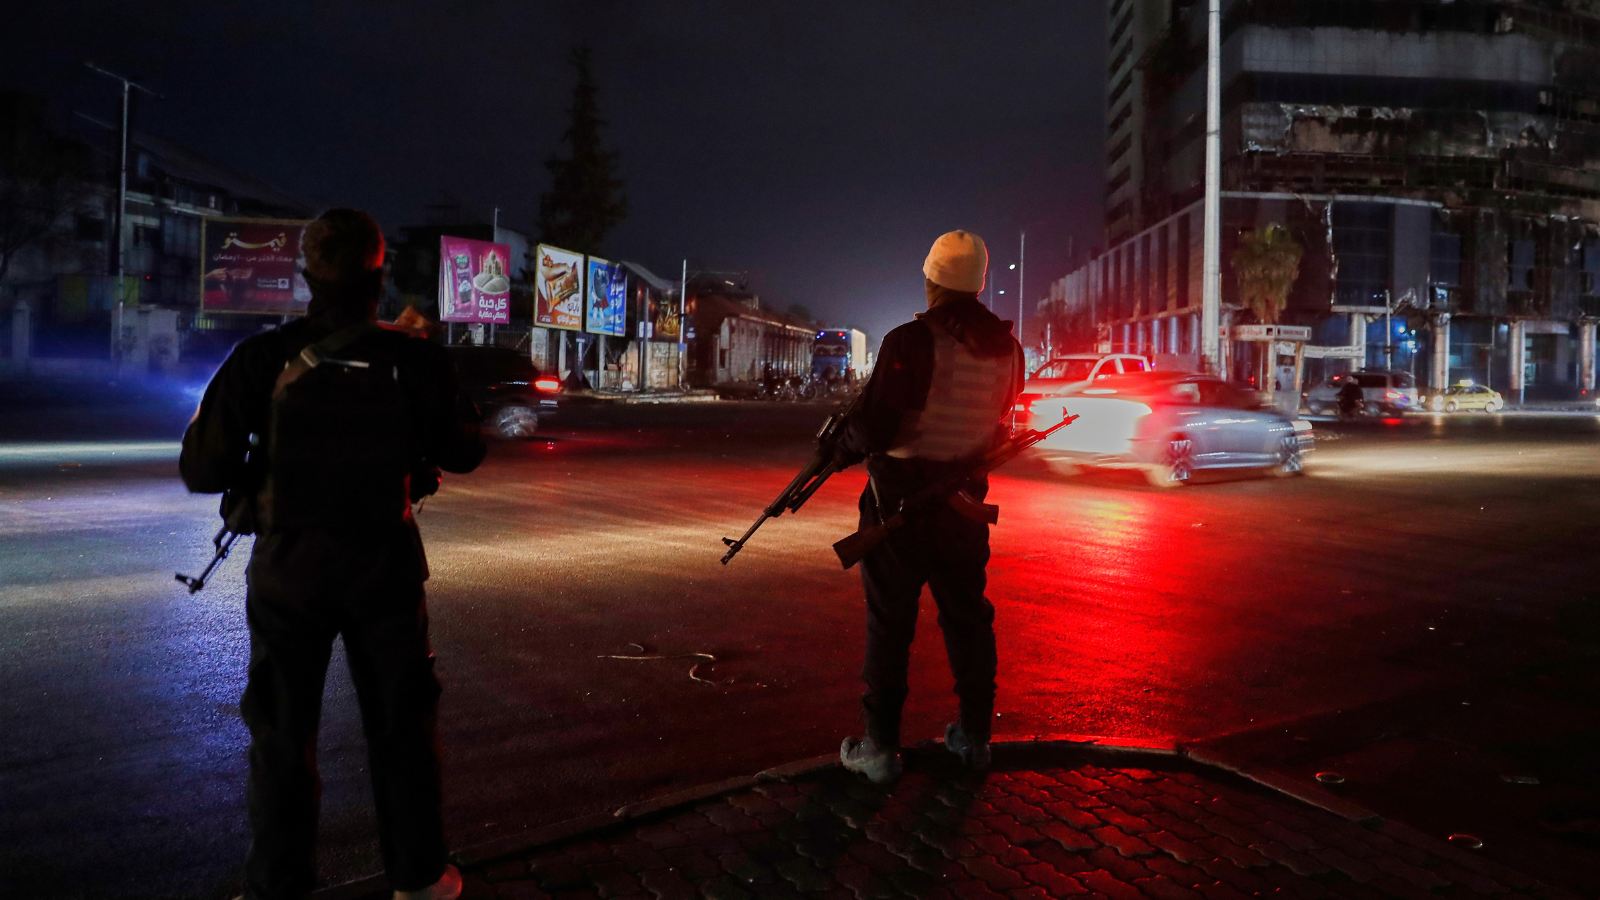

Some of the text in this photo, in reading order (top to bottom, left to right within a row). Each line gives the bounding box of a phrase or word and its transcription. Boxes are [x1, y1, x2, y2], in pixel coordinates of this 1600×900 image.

[220, 232, 287, 252] فيمتو
[212, 253, 236, 261] رمضان
[479, 295, 507, 311] كل حبة
